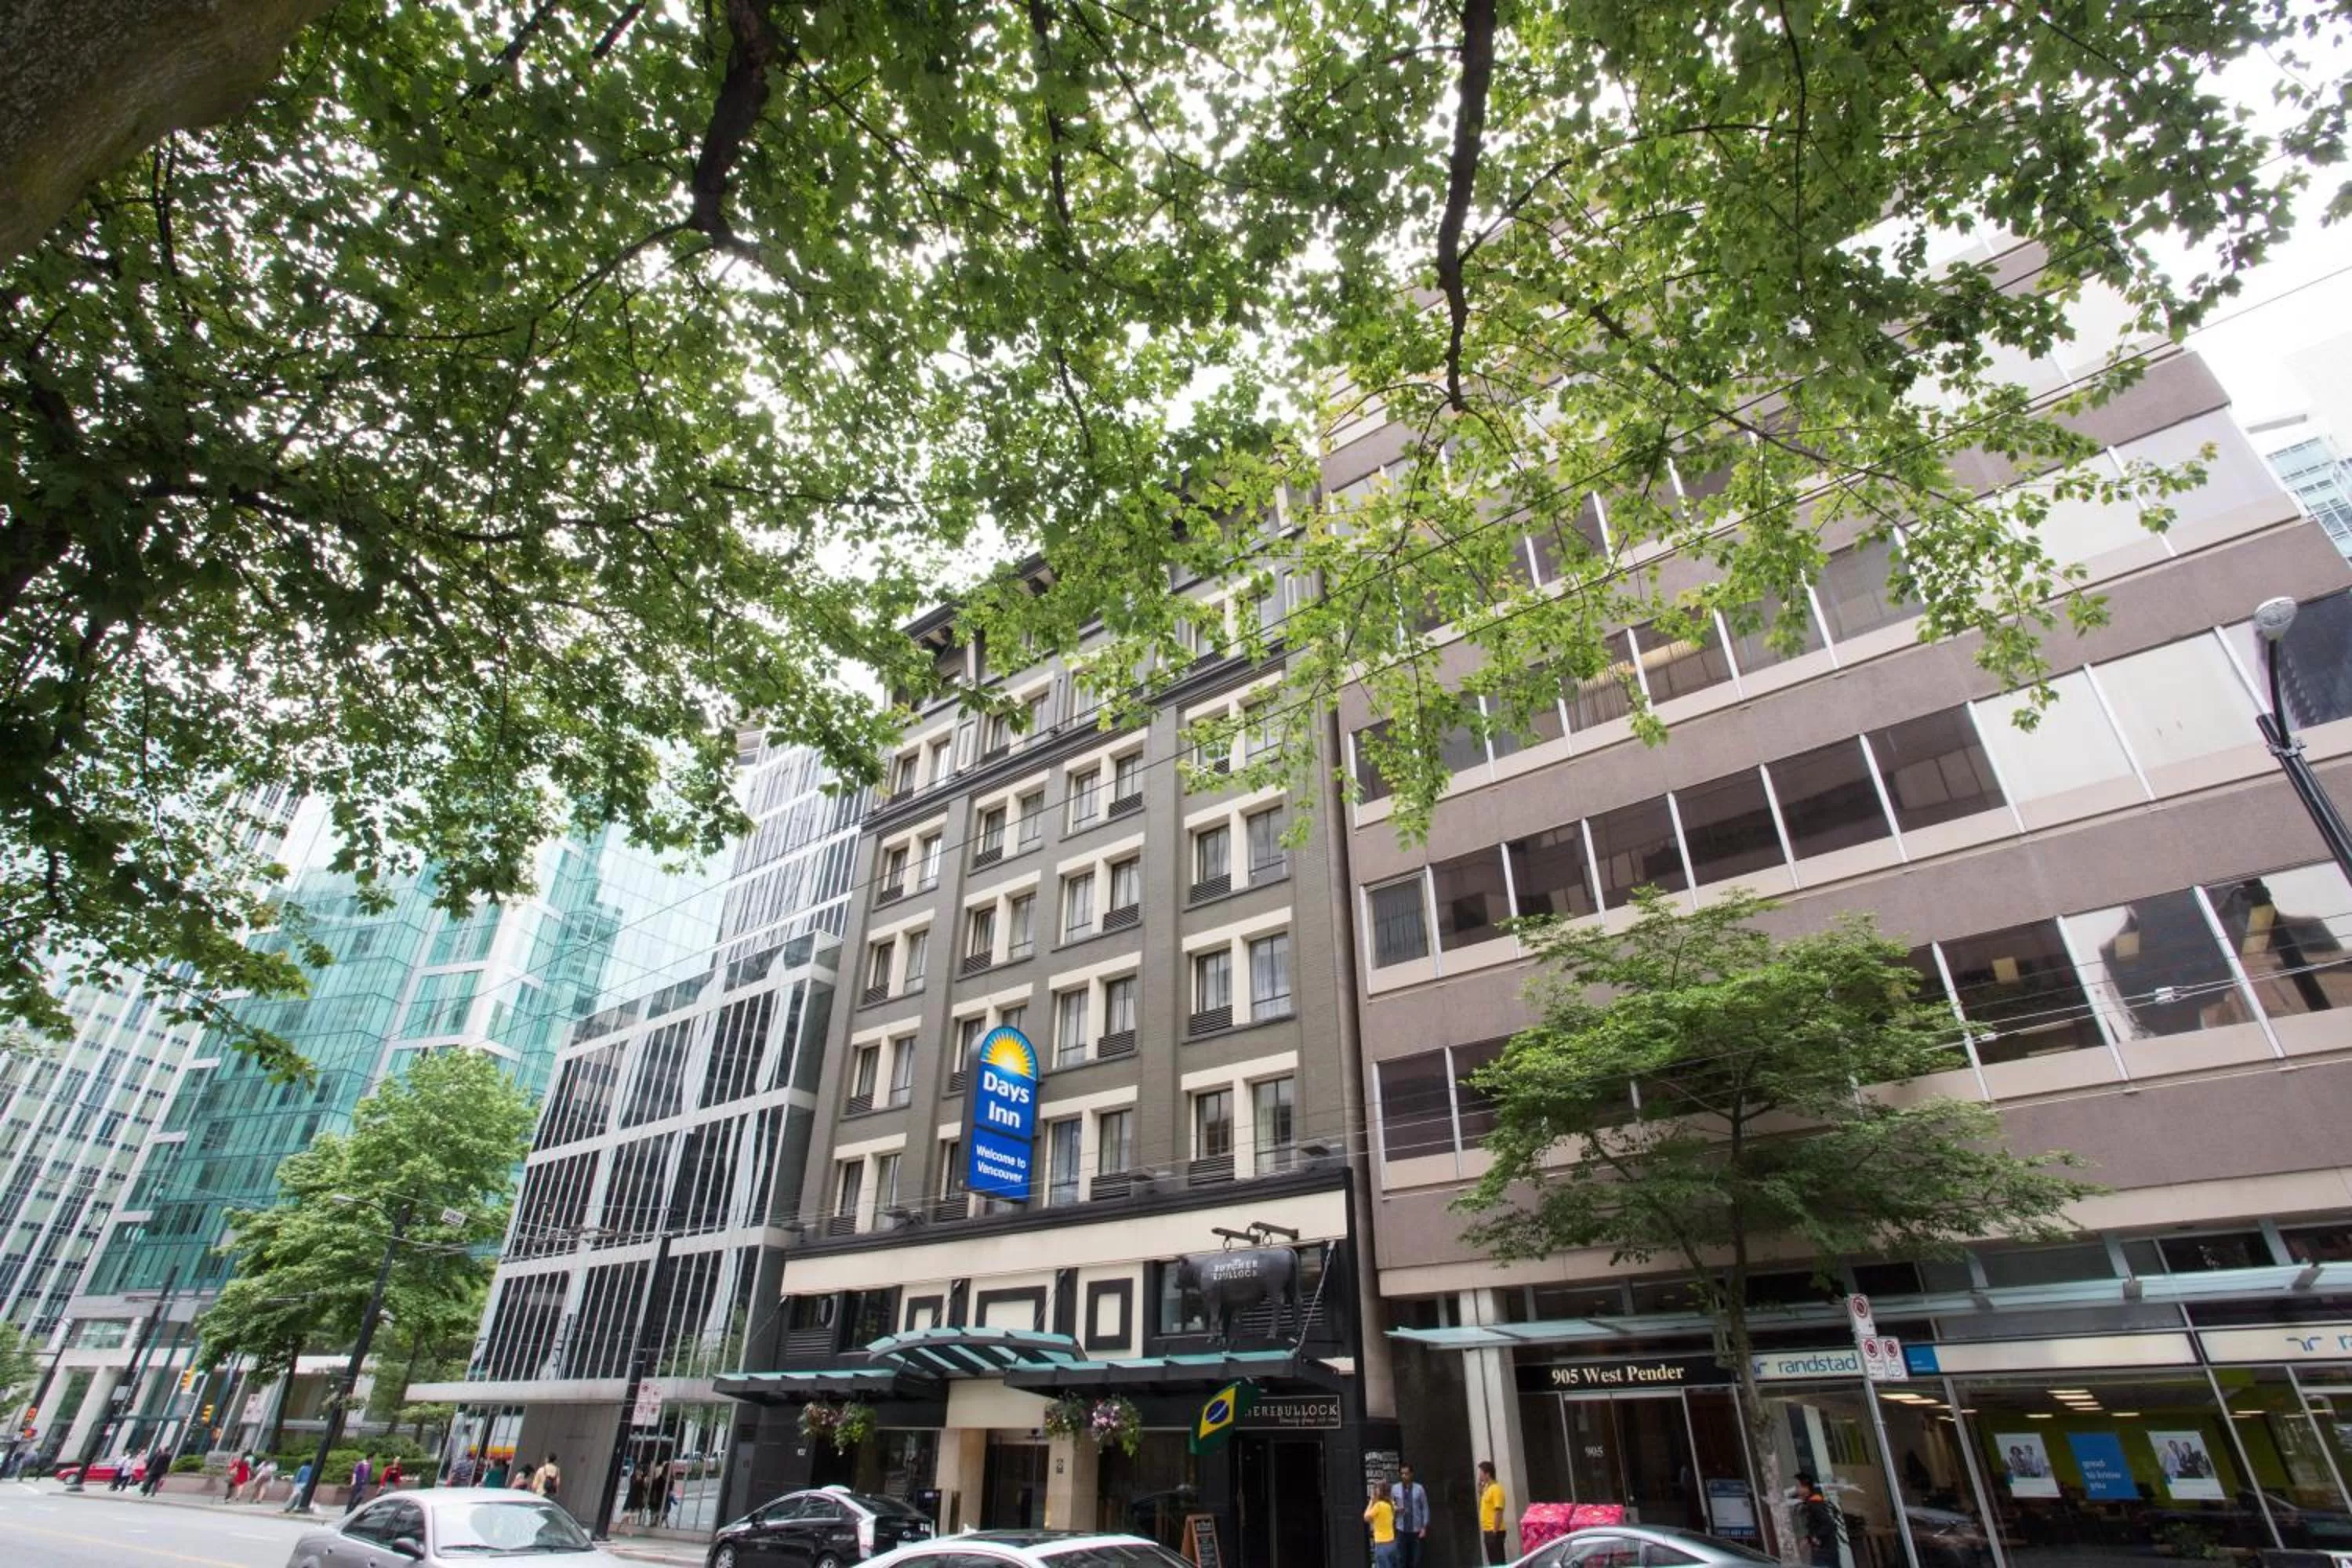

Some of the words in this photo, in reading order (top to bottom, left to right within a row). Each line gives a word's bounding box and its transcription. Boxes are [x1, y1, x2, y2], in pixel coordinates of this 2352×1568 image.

[982, 1070, 1029, 1104] Days
[988, 1101, 1021, 1128] Inn
[976, 1144, 1015, 1166] Welcome
[1017, 1156, 1026, 1169] to
[977, 1160, 1023, 1182] Vancouver
[1777, 1352, 1858, 1373] randstad
[1552, 1368, 1579, 1385] 905
[1582, 1367, 1623, 1384] West
[1626, 1364, 1684, 1381] Pender
